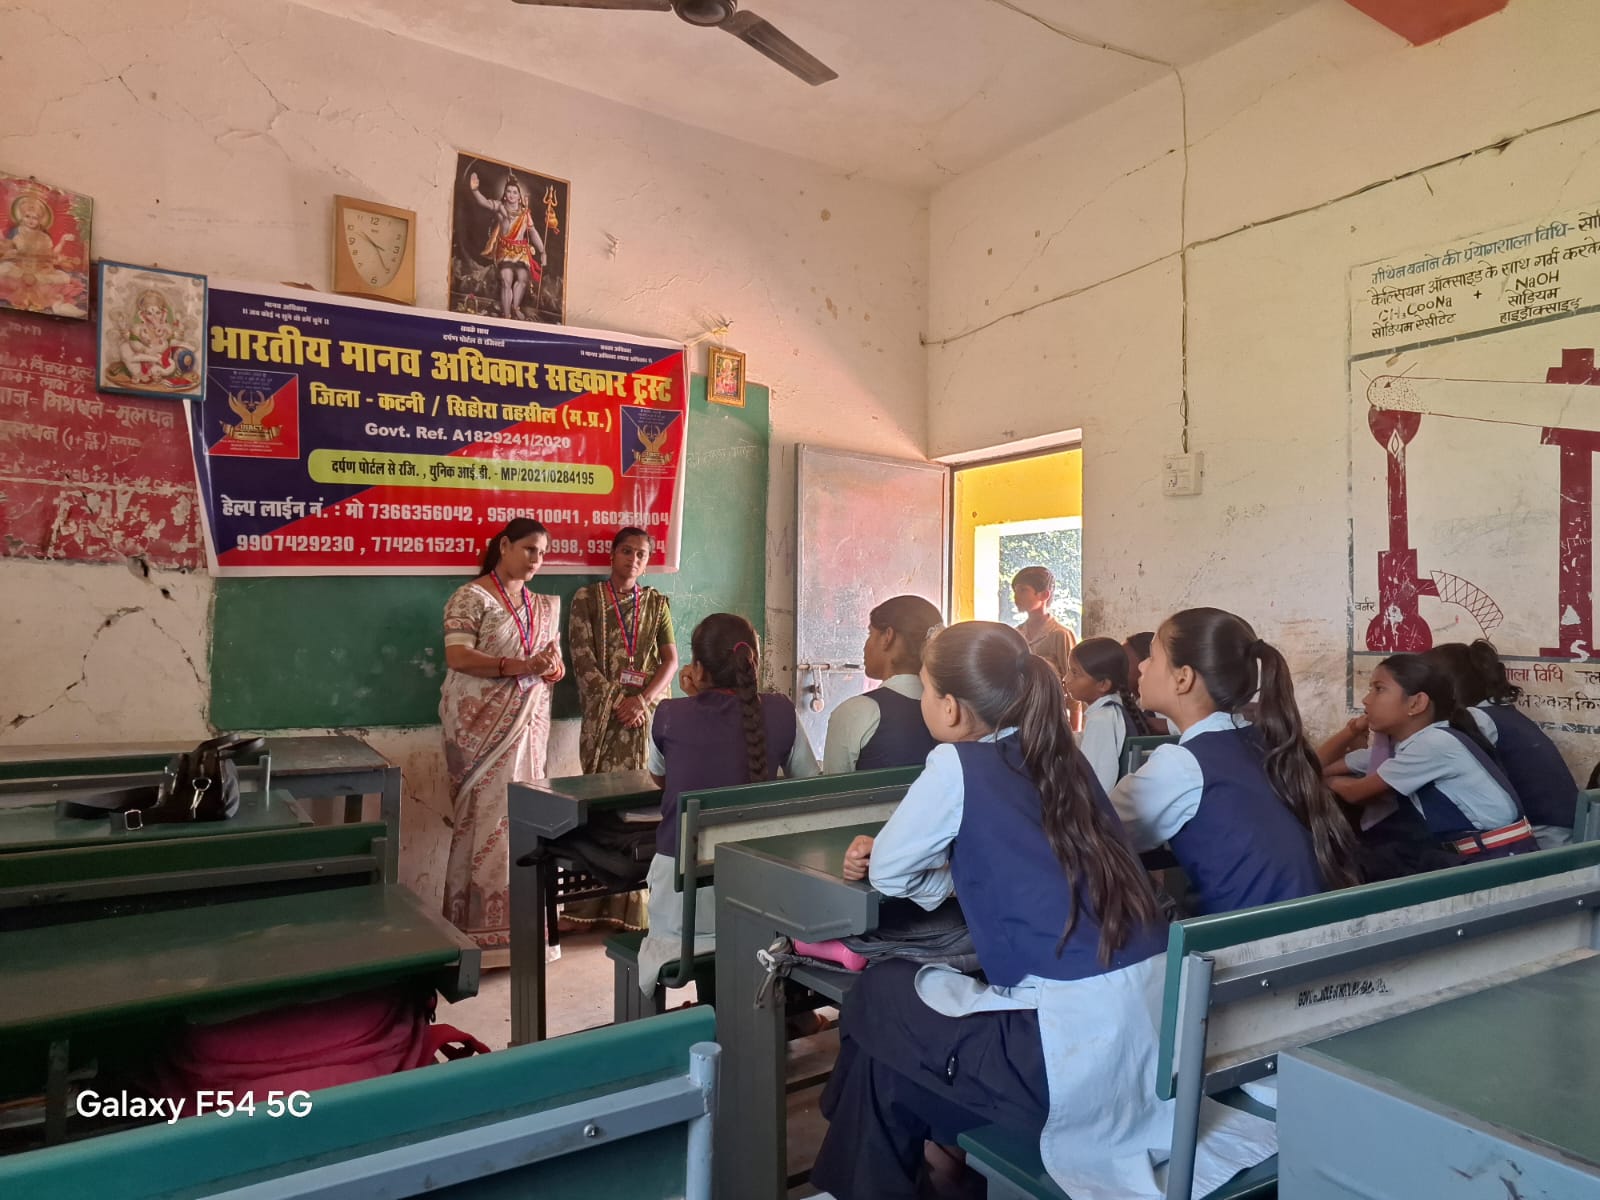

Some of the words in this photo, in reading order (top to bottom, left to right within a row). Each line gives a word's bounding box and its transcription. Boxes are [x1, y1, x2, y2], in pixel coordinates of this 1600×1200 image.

[1442, 249, 1463, 266] की
[1478, 260, 1498, 279] के
[1501, 257, 1530, 276] साथ
[1534, 247, 1560, 267] गर्म
[1515, 270, 1560, 290] NaOH
[1505, 287, 1561, 307] सोडियम
[210, 325, 332, 368] भारतीय
[339, 340, 422, 378] मानव
[431, 346, 539, 389] अधिकार
[544, 363, 627, 398] सहकार
[630, 373, 673, 406] ट्रस्ट
[309, 381, 361, 408] जिला
[377, 391, 426, 414] कटनी
[431, 395, 440, 417] /
[446, 394, 498, 420] सिहोरा
[502, 401, 557, 425] तहसील
[561, 405, 612, 433] (म.प्र.)
[364, 422, 411, 439] Govt.
[416, 426, 448, 440] Ref.
[452, 429, 571, 449] A1829241/2020
[331, 457, 356, 475] दर्पण
[358, 458, 385, 475] पोर्टल
[387, 459, 396, 476] से
[501, 467, 595, 485] MP/2021/0284195
[220, 494, 256, 517] हेल्प
[260, 496, 306, 520] लाईन
[346, 498, 364, 519] मो
[369, 503, 473, 522] 7366356042
[236, 535, 355, 552] 9907429230
[1534, 663, 1563, 684] विधि
